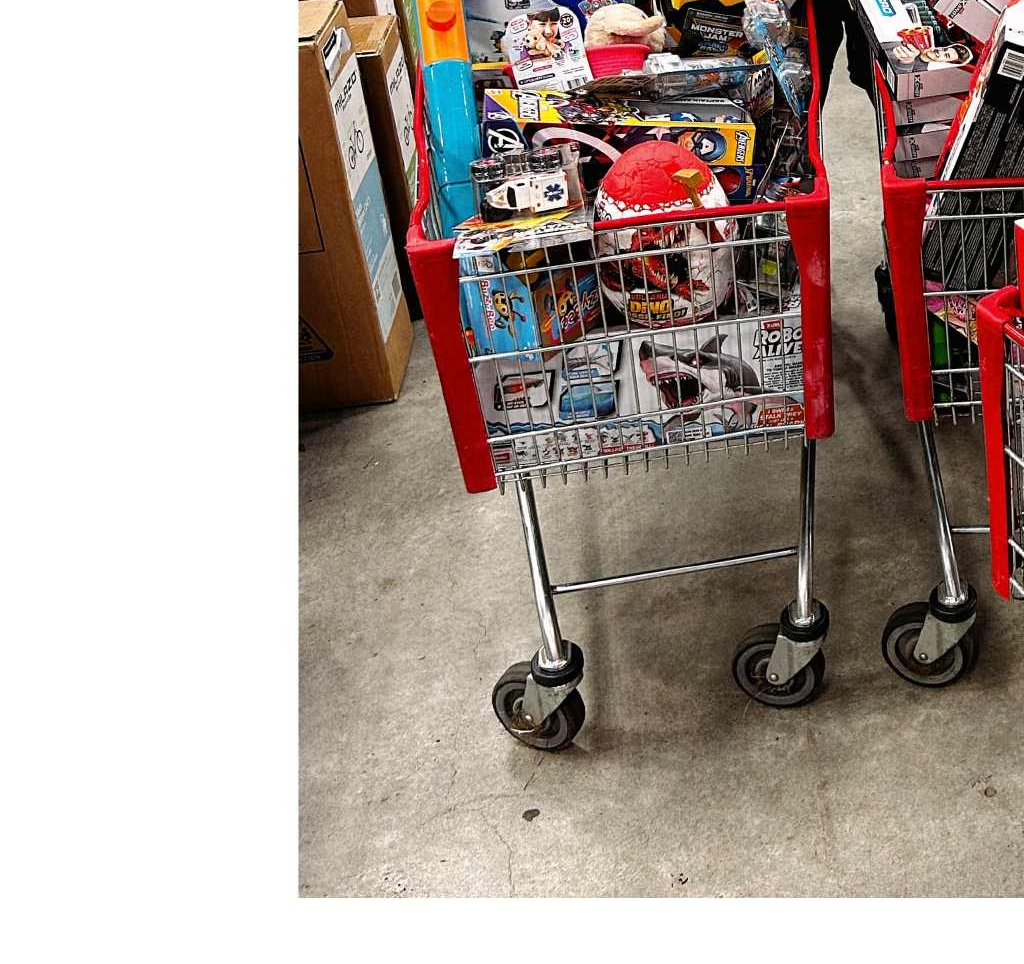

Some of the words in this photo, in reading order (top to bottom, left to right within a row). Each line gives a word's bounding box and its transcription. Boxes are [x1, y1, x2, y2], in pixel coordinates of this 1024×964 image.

[690, 24, 743, 38] MONSTER
[705, 33, 728, 42] JAM
[754, 326, 803, 347] ROBO
[753, 342, 803, 359] ALIVE
